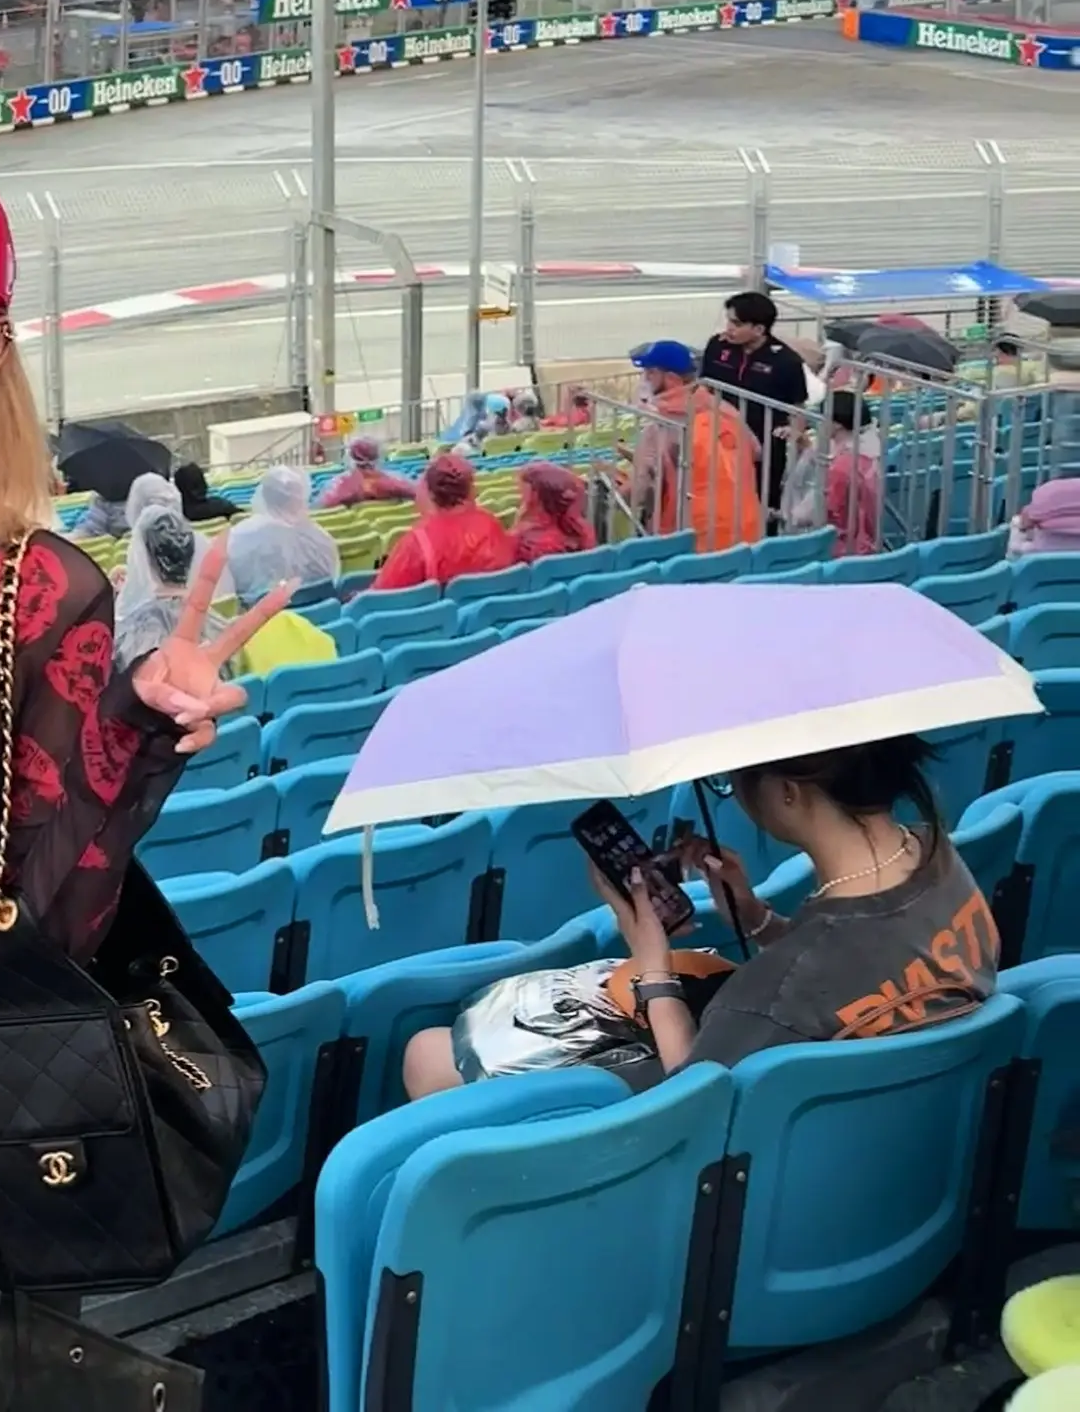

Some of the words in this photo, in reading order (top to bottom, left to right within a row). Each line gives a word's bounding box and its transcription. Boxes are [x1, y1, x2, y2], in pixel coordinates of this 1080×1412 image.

[917, 22, 1011, 58] Heineken
[261, 52, 314, 79] Heinek
[92, 72, 177, 105] Heineken
